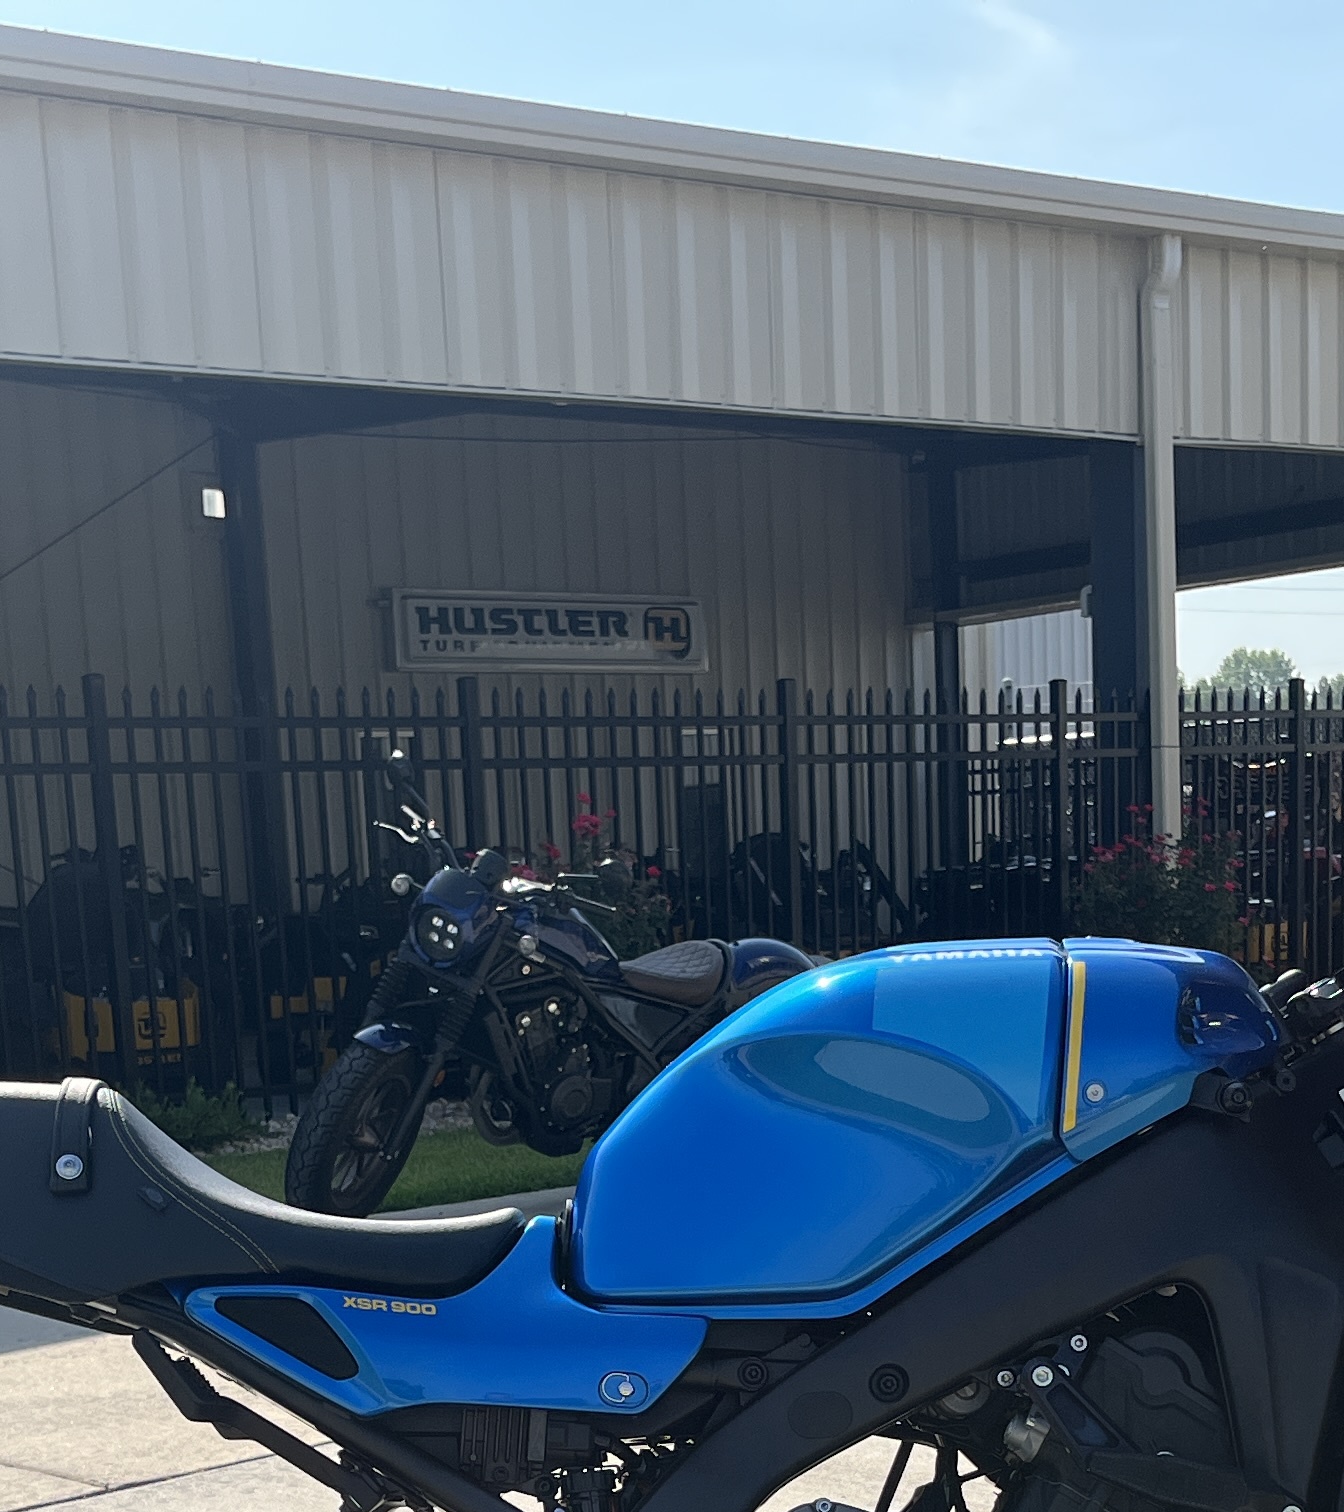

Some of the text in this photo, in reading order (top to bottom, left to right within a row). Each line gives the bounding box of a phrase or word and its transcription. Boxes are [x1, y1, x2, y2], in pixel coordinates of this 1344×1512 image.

[415, 606, 629, 638] HUSTLER
[889, 949, 1043, 964] YAMAHA
[343, 1296, 437, 1316] XSR 900
